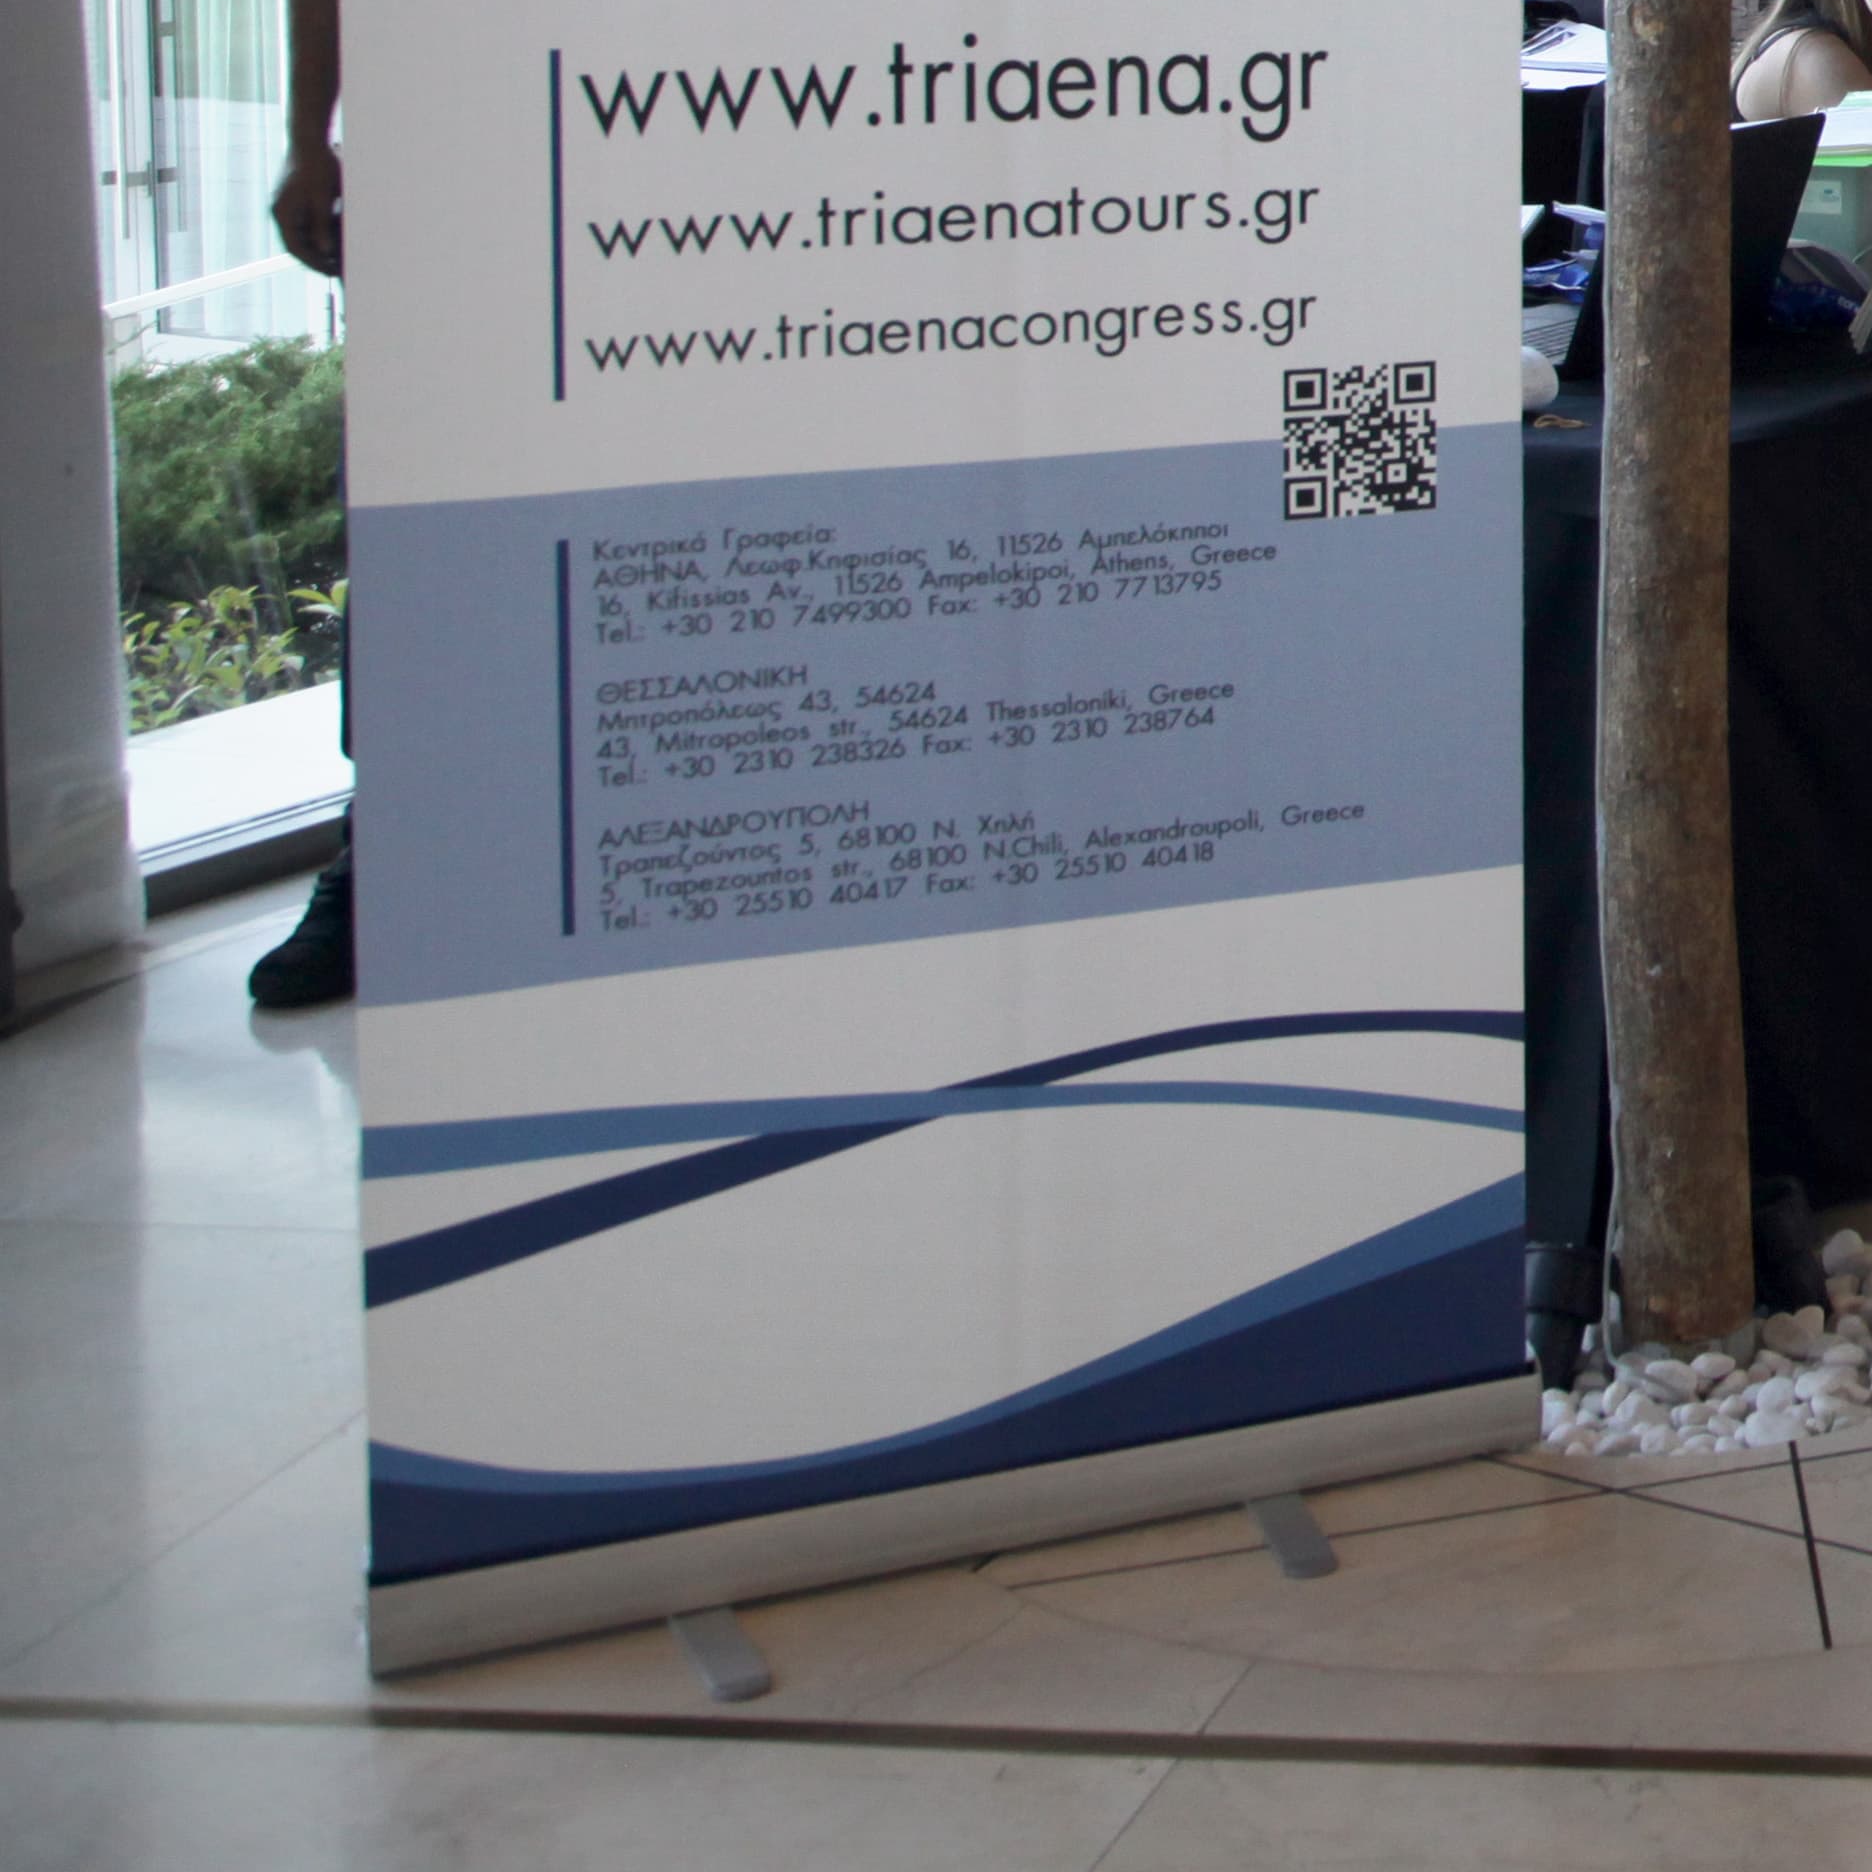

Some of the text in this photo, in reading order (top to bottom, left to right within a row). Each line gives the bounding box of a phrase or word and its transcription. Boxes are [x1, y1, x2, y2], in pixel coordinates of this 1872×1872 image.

[580, 34, 1328, 142] www.triaena.gr
[588, 183, 1319, 259] www.triaenatours.gr
[586, 289, 1317, 371] www.triaenacongress.gr
[593, 524, 837, 562] Κεντρικά Γραφεία:
[948, 539, 979, 564] 16,
[999, 532, 1063, 555] 11526
[600, 596, 630, 619] 16,
[648, 588, 749, 609] Kifissias
[837, 572, 901, 593] 11526
[920, 562, 1075, 594] Ampelokipoi,
[1091, 550, 1175, 578] Athens,
[1192, 544, 1277, 565] Greece
[663, 614, 712, 636] +30
[731, 608, 775, 632] 210
[794, 597, 911, 626] 7499300
[928, 589, 978, 615] Fax:
[995, 583, 1040, 609] +30
[1058, 581, 1099, 605] 210
[1116, 569, 1221, 598] 7713795
[597, 736, 634, 761] 43,
[657, 724, 809, 758] Mitropoleos
[890, 705, 968, 730] 54624
[986, 689, 1130, 721] Thessaloniki,
[1148, 683, 1234, 705] Greece
[799, 689, 837, 712] 43,
[856, 681, 935, 708] 54624
[666, 755, 714, 778] +30
[734, 747, 793, 774] 2310
[812, 738, 906, 766] 238326
[923, 734, 974, 754] Fax:
[989, 725, 1035, 747] +30
[1053, 717, 1107, 742] 2310
[1125, 706, 1214, 734] 238764
[601, 882, 624, 906] 5,
[643, 863, 811, 902] Trapezountos
[890, 843, 966, 870] 68100
[1086, 809, 1264, 847] Alexandroupoli,
[1281, 805, 1364, 826] Greece
[800, 833, 822, 857] 5,
[839, 822, 916, 850] 68100
[979, 811, 1034, 834] Χηλή
[669, 898, 717, 920] +30
[737, 887, 812, 916] 25510
[830, 876, 907, 903] 40417
[926, 873, 975, 893] Fax:
[994, 862, 1038, 884] +30
[1056, 852, 1126, 880] 25510
[1142, 840, 1214, 866] 40418
